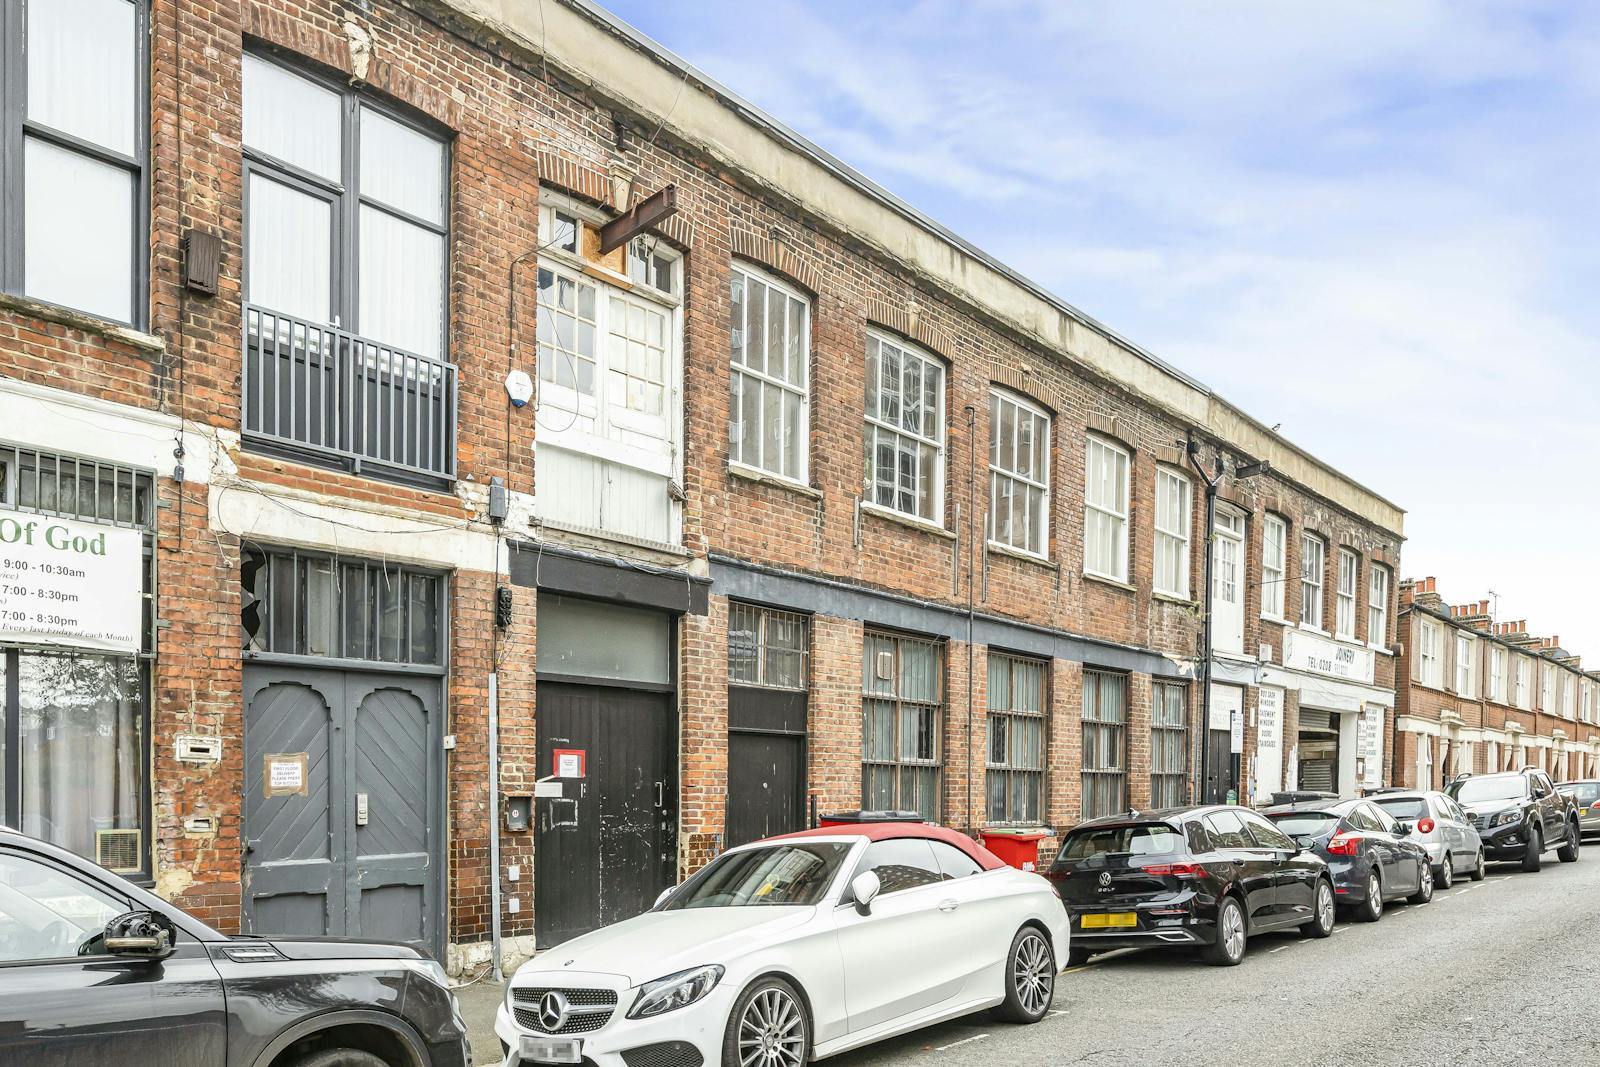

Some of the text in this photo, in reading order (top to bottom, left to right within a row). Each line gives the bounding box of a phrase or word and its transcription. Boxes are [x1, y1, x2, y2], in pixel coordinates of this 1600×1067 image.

[0, 518, 107, 556] Of God
[4, 559, 28, 571] 9:00
[40, 563, 86, 578] 10:30am
[2, 584, 27, 596] 7:00
[37, 588, 79, 603] 8:30pm
[1, 610, 26, 621] 7:00
[36, 613, 78, 627] 8:30pm
[2, 623, 27, 633] Every
[29, 626, 44, 634] last
[46, 627, 72, 638] Friday
[74, 630, 85, 638] of
[105, 632, 134, 642] Month)
